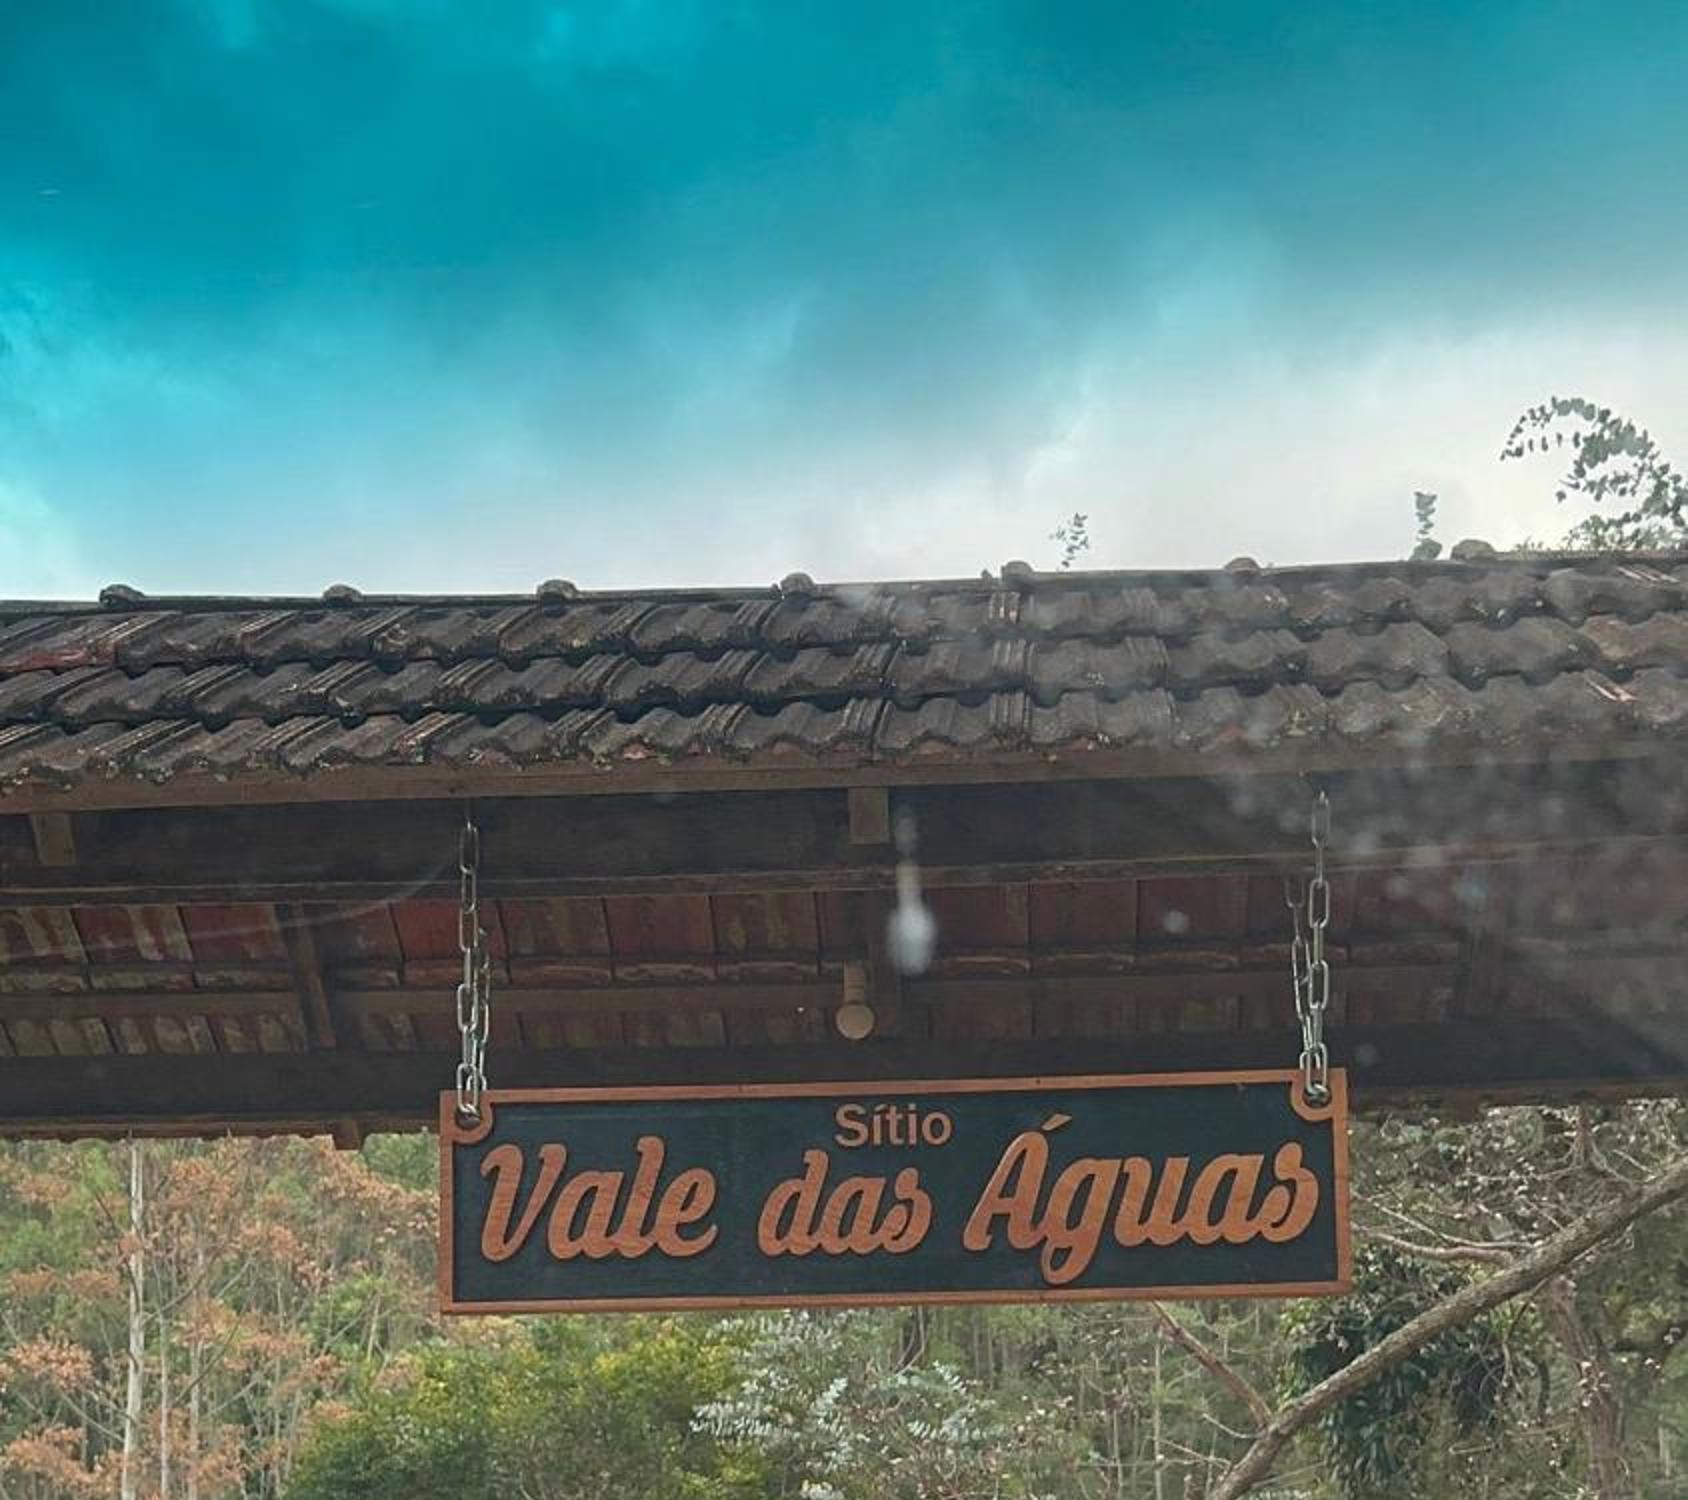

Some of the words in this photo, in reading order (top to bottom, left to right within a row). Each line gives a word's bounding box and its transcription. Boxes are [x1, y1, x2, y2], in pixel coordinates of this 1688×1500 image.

[835, 1103, 953, 1146] Sítio
[481, 1136, 718, 1261] Vale
[758, 1149, 932, 1255] das
[964, 1114, 1319, 1284] Águas
